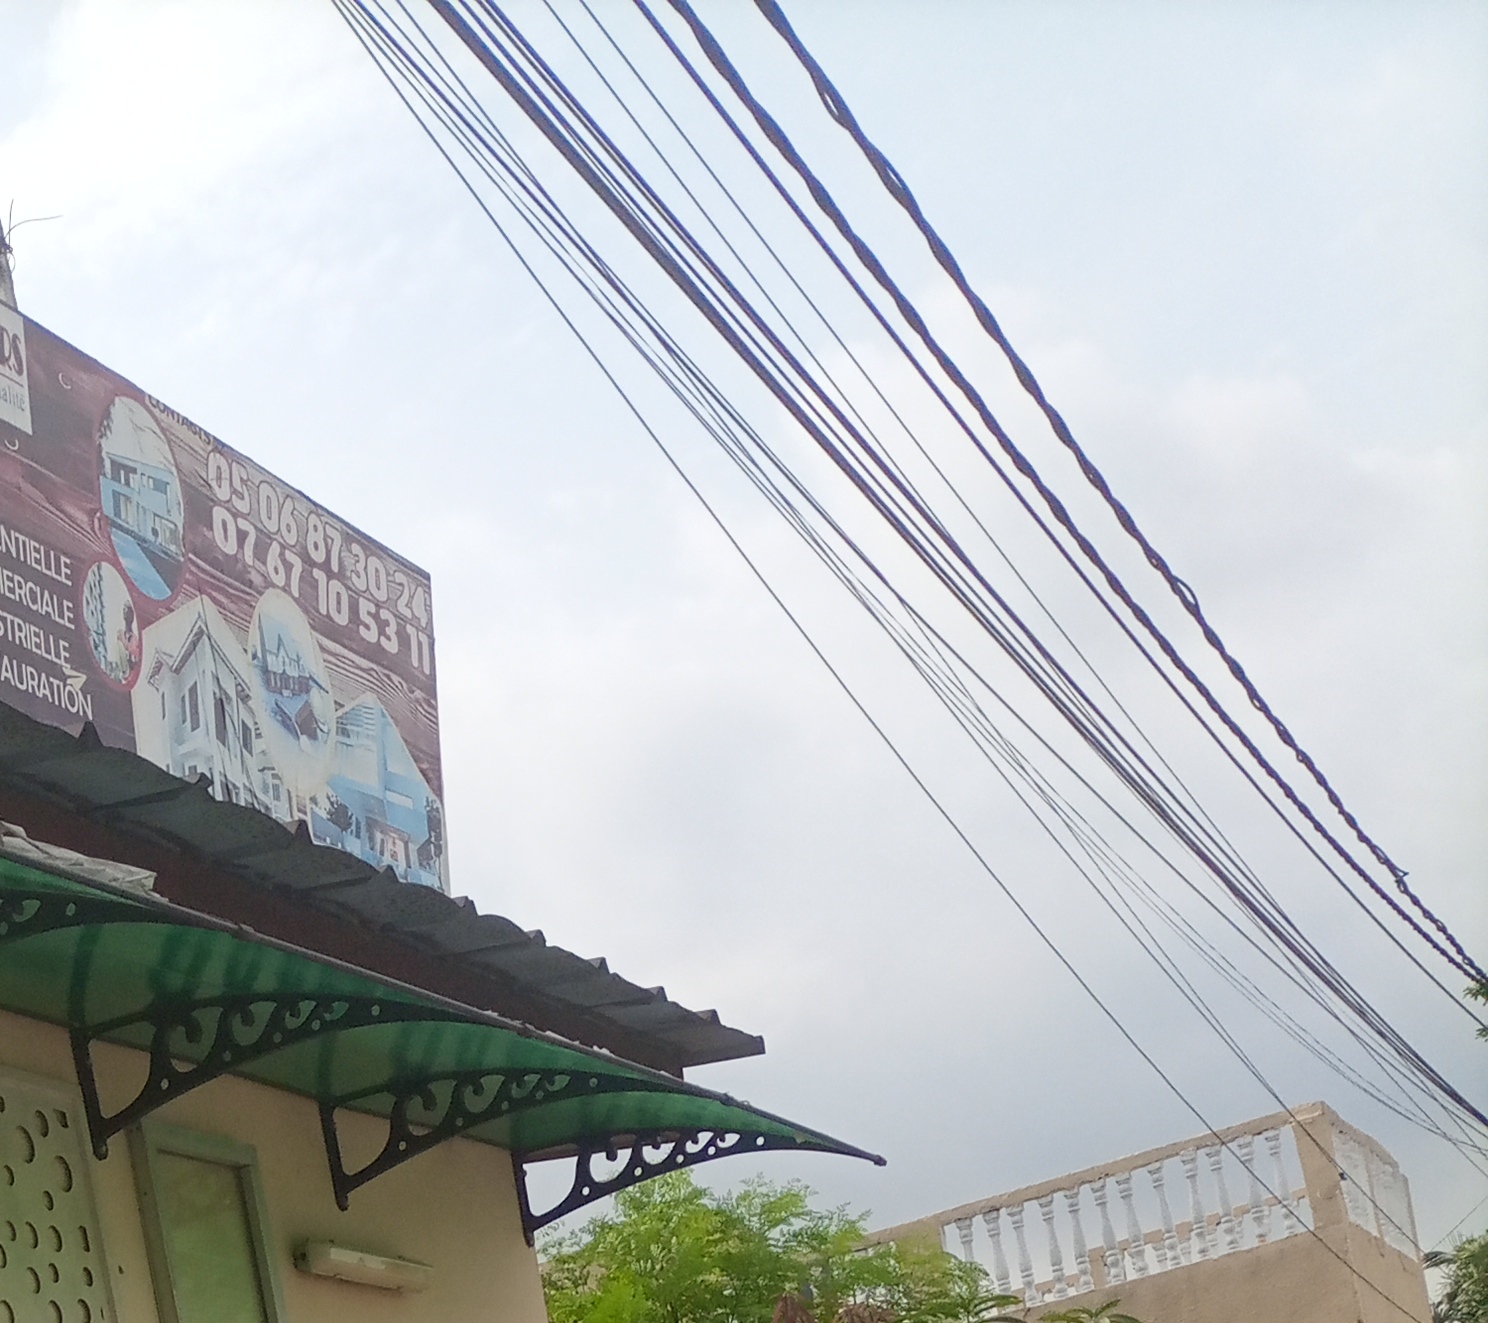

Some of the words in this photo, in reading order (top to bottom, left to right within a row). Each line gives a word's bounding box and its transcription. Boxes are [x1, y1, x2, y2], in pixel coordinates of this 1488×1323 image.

[207, 450, 250, 512] 05
[258, 480, 299, 546] 06
[306, 512, 343, 573] 87
[351, 542, 388, 603] 30
[396, 572, 429, 628] 24
[212, 506, 255, 566] 07
[266, 544, 303, 597] 67
[312, 572, 349, 626] 10
[358, 601, 399, 654] 53
[408, 624, 432, 676] 11
